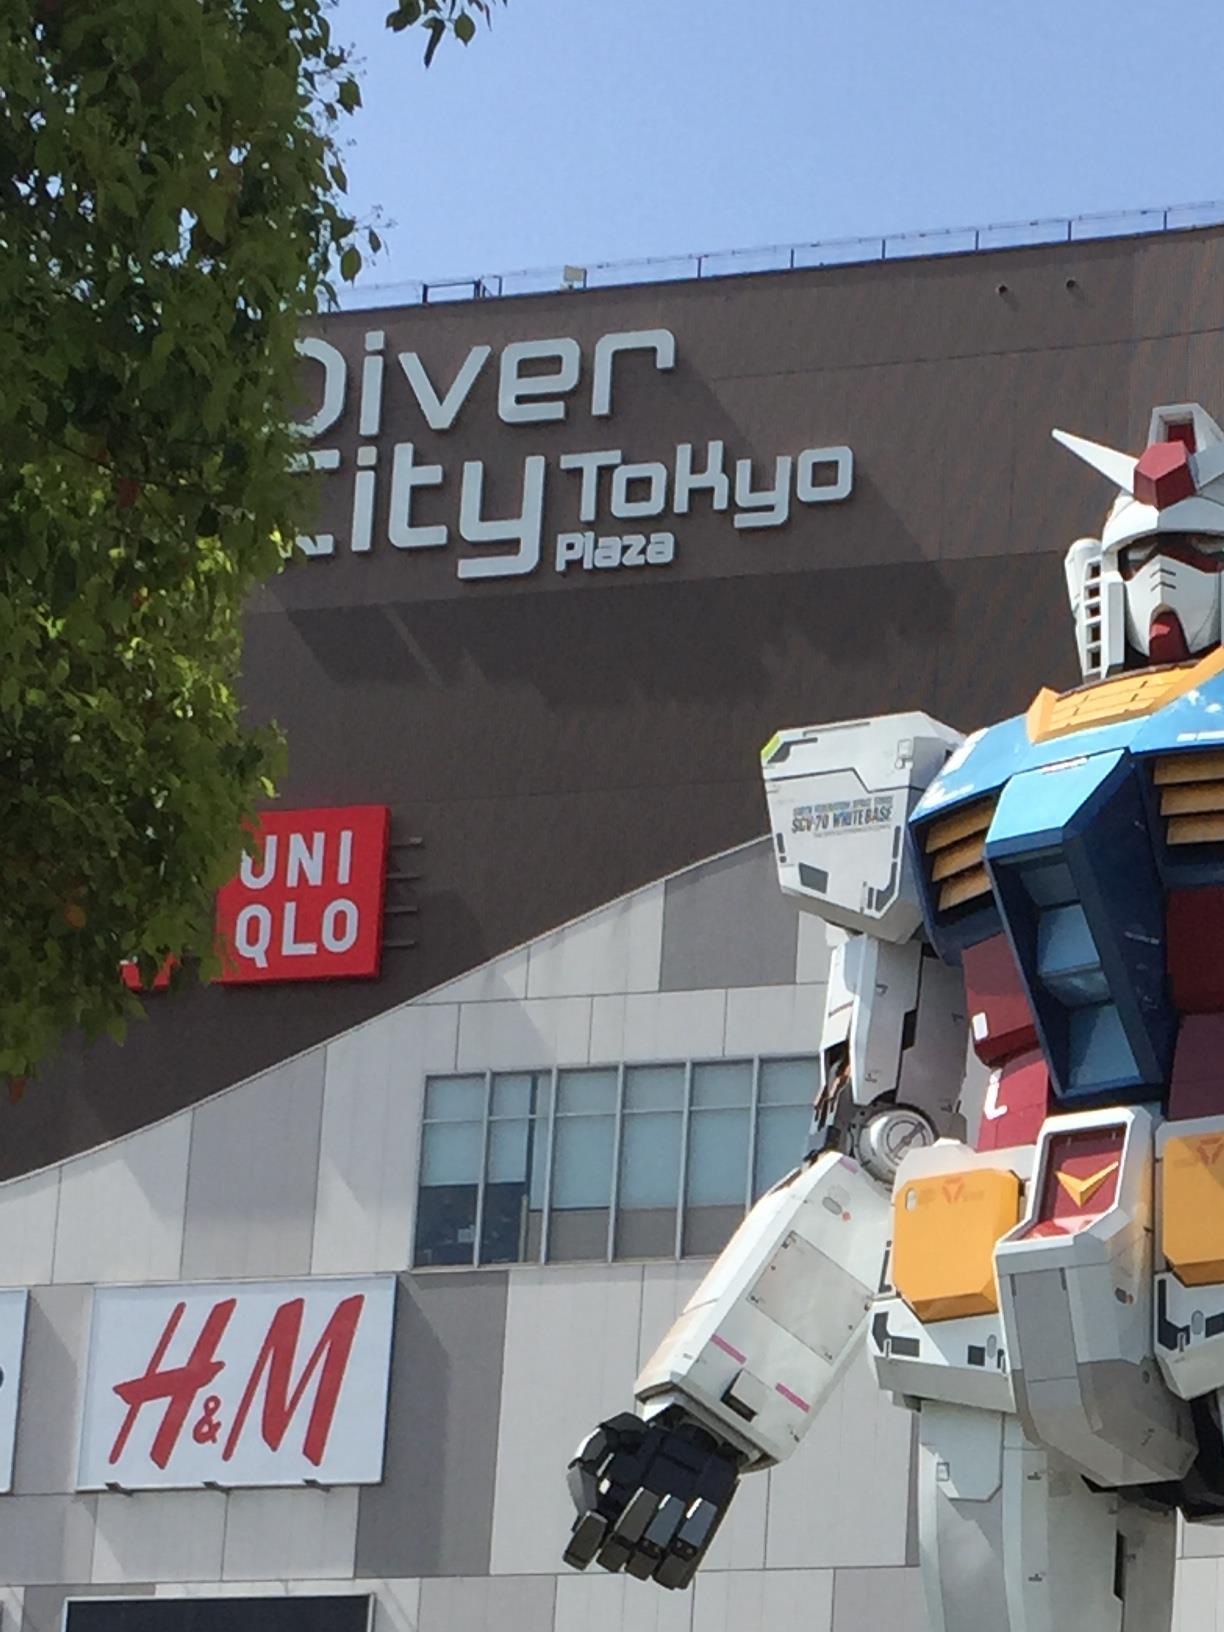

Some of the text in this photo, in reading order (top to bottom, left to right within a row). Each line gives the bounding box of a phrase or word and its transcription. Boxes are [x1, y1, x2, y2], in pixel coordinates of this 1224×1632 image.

[289, 328, 676, 438] Diver
[559, 440, 855, 530] Tokyo
[555, 531, 675, 572] Plaza
[239, 830, 353, 890] UNI
[234, 898, 359, 968] QLO
[109, 1294, 366, 1470] H&M
